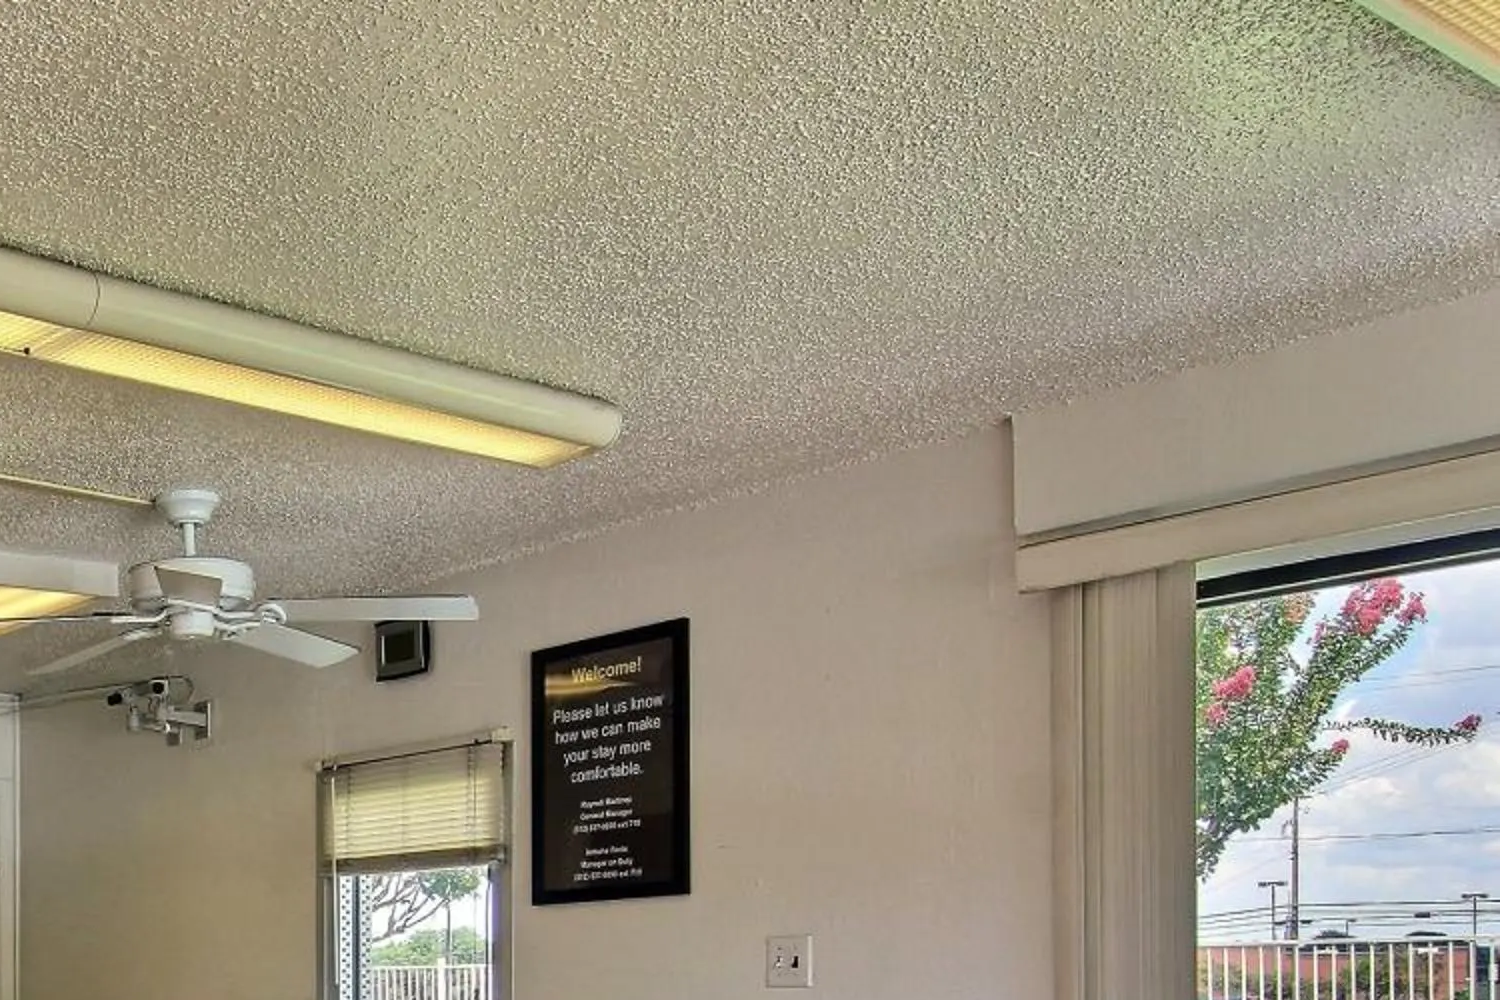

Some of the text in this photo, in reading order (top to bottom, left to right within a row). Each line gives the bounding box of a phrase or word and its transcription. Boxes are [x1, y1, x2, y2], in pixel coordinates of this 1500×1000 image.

[572, 656, 642, 683] Welcome!
[553, 695, 664, 724] Please let us know
[555, 716, 661, 744] how we can make
[563, 740, 651, 768] your stay more
[571, 761, 644, 783] comfortable.
